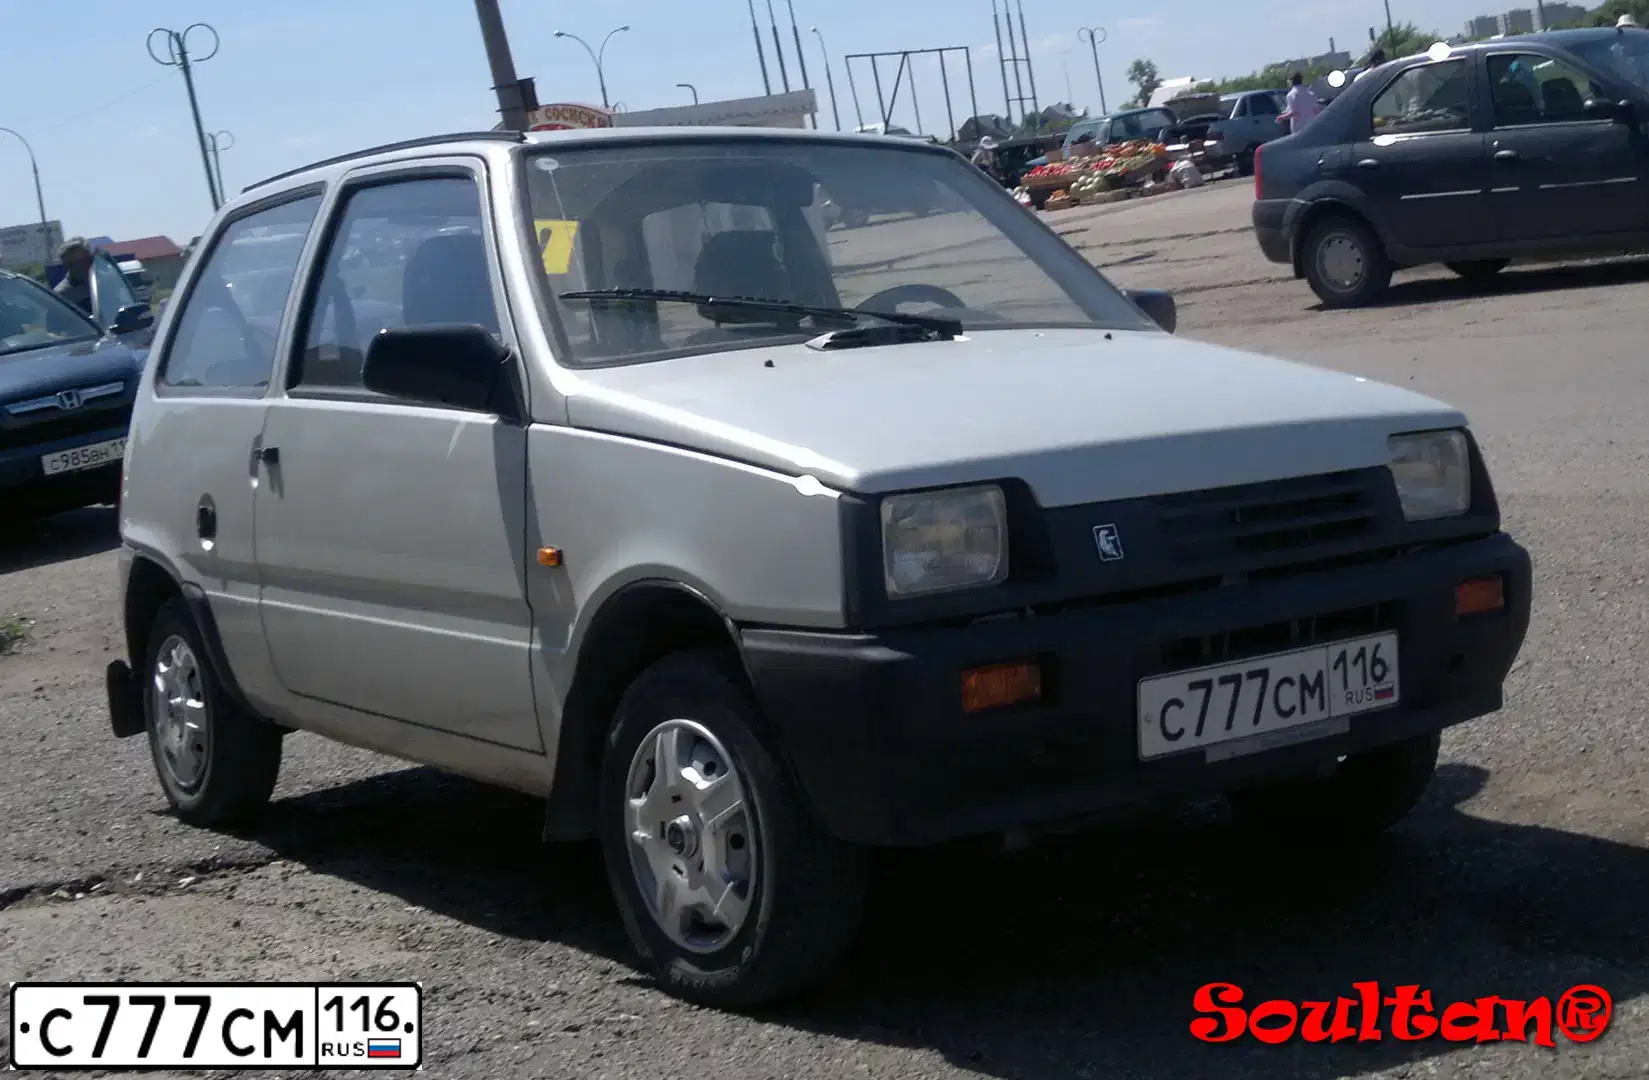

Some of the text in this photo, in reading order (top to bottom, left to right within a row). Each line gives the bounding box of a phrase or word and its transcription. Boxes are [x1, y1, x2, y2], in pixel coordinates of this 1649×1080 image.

[1159, 643, 1387, 741] С777СМ 116
[1344, 687, 1373, 706] RUS
